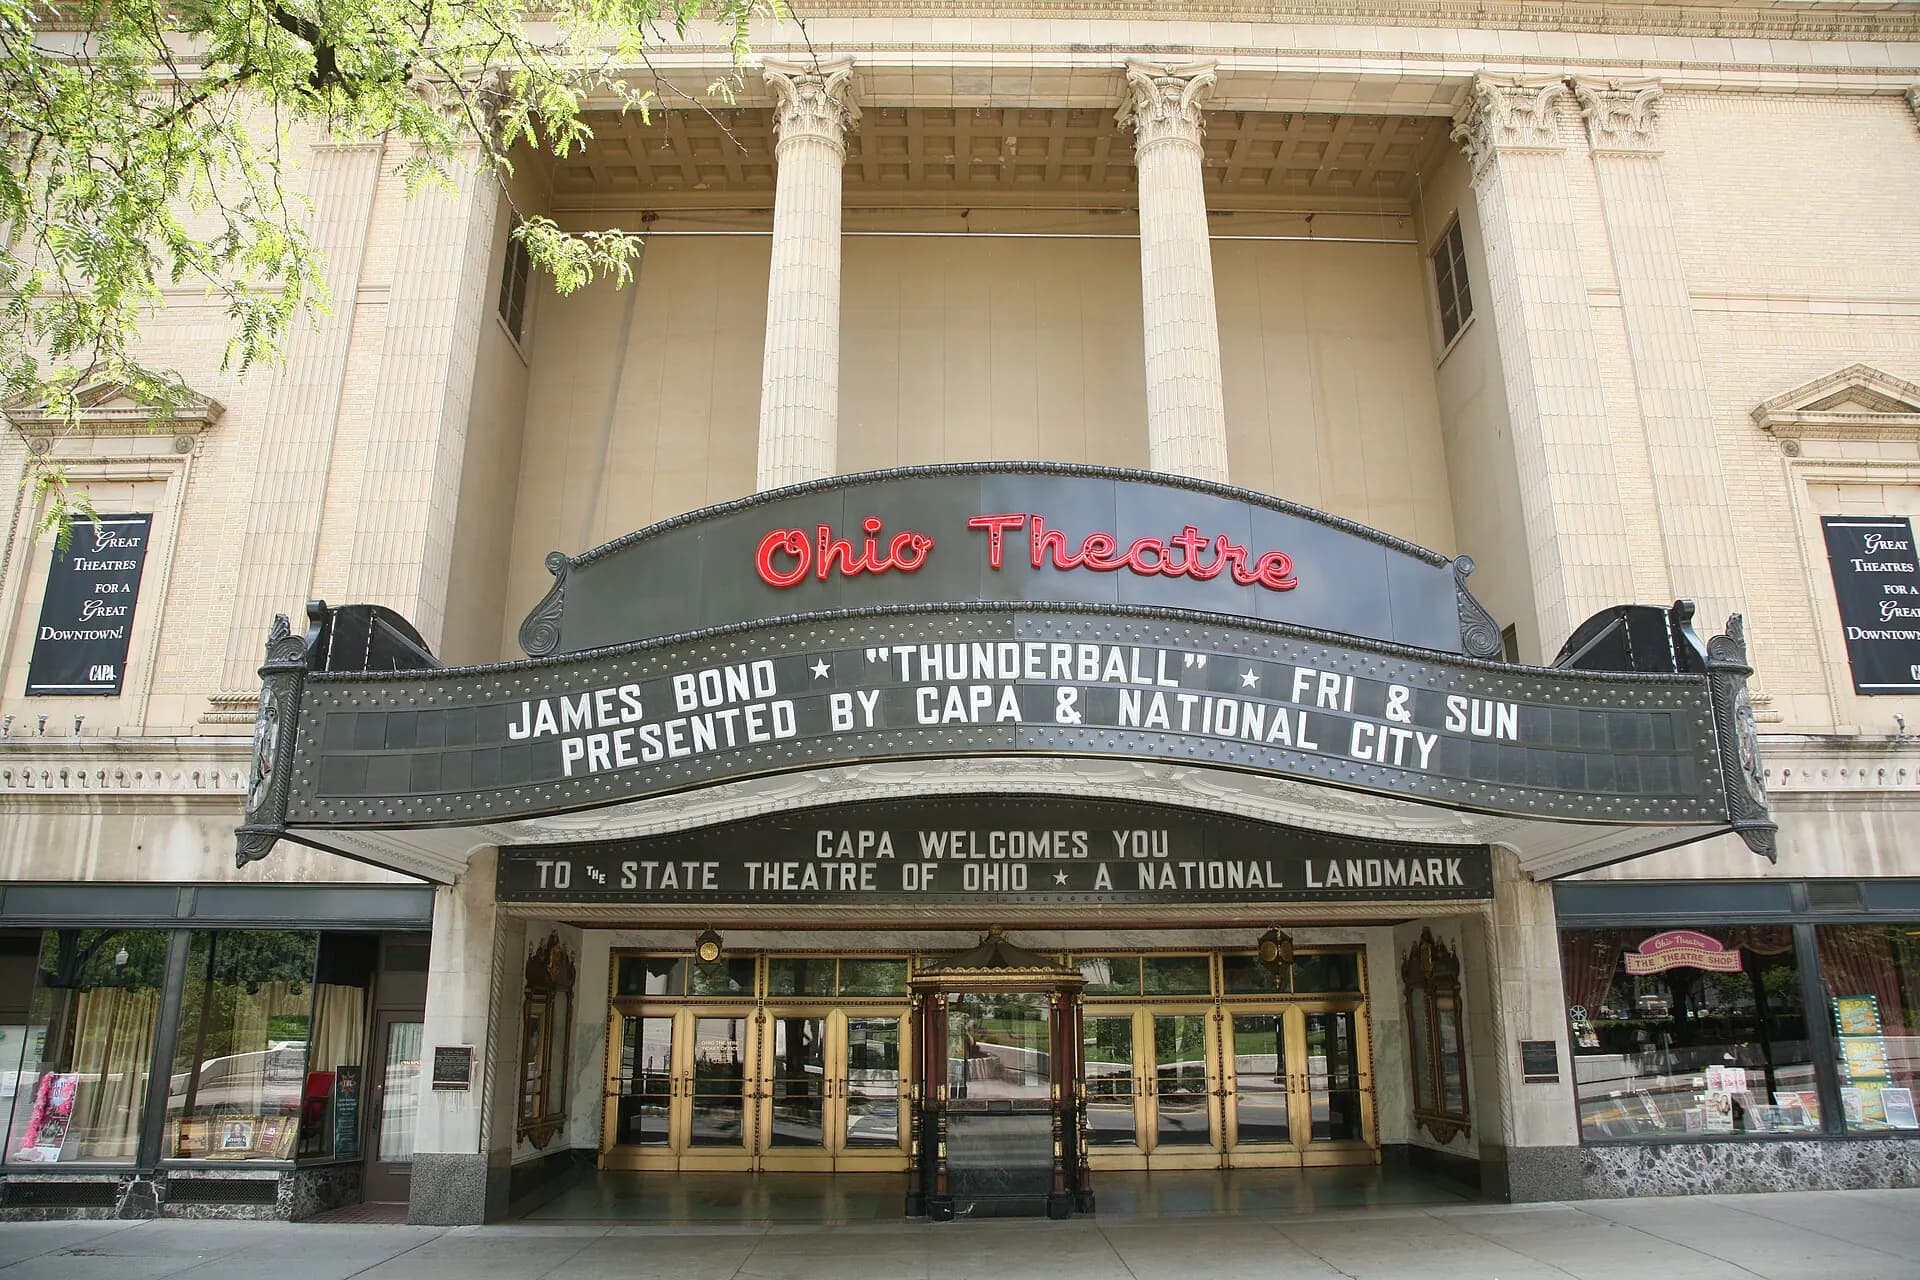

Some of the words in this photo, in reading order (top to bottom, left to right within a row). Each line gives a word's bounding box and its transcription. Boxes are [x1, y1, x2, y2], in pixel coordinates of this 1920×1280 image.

[755, 515, 935, 588] Ohio
[967, 512, 1298, 591] Theatre
[95, 583, 119, 594] FOR
[121, 583, 131, 593] A
[1883, 584, 1908, 595] FOR
[1910, 585, 1919, 595] A
[89, 665, 117, 681] CAPA
[508, 684, 643, 741] JAMES
[672, 659, 777, 713] BOND
[865, 643, 1207, 688] "THUNDERBALL"
[1291, 666, 1354, 713] FRI
[1385, 684, 1412, 723] &
[1445, 694, 1518, 741] SUN
[561, 700, 797, 777] PRESENTED
[829, 689, 880, 732] BY
[916, 685, 1023, 725] CAPA
[1055, 686, 1082, 725] &
[1118, 689, 1318, 750] NATIONAL
[1350, 721, 1438, 769] CITY
[816, 830, 895, 859] CAPA
[918, 830, 1088, 859] WELCOMES
[1113, 830, 1169, 858] YOU
[536, 861, 571, 889] TO
[586, 865, 606, 884] THE
[621, 861, 719, 890] STATE
[744, 862, 877, 891] THEATRE
[902, 863, 938, 891] OF
[963, 863, 1028, 891] OHIO
[1094, 863, 1114, 890] A
[1137, 860, 1283, 890] NATIONAL
[1305, 858, 1465, 888] LANDMARK
[1635, 958, 1655, 968] THE
[1662, 953, 1704, 963] THEATRE
[1707, 956, 1733, 966] SHOP
